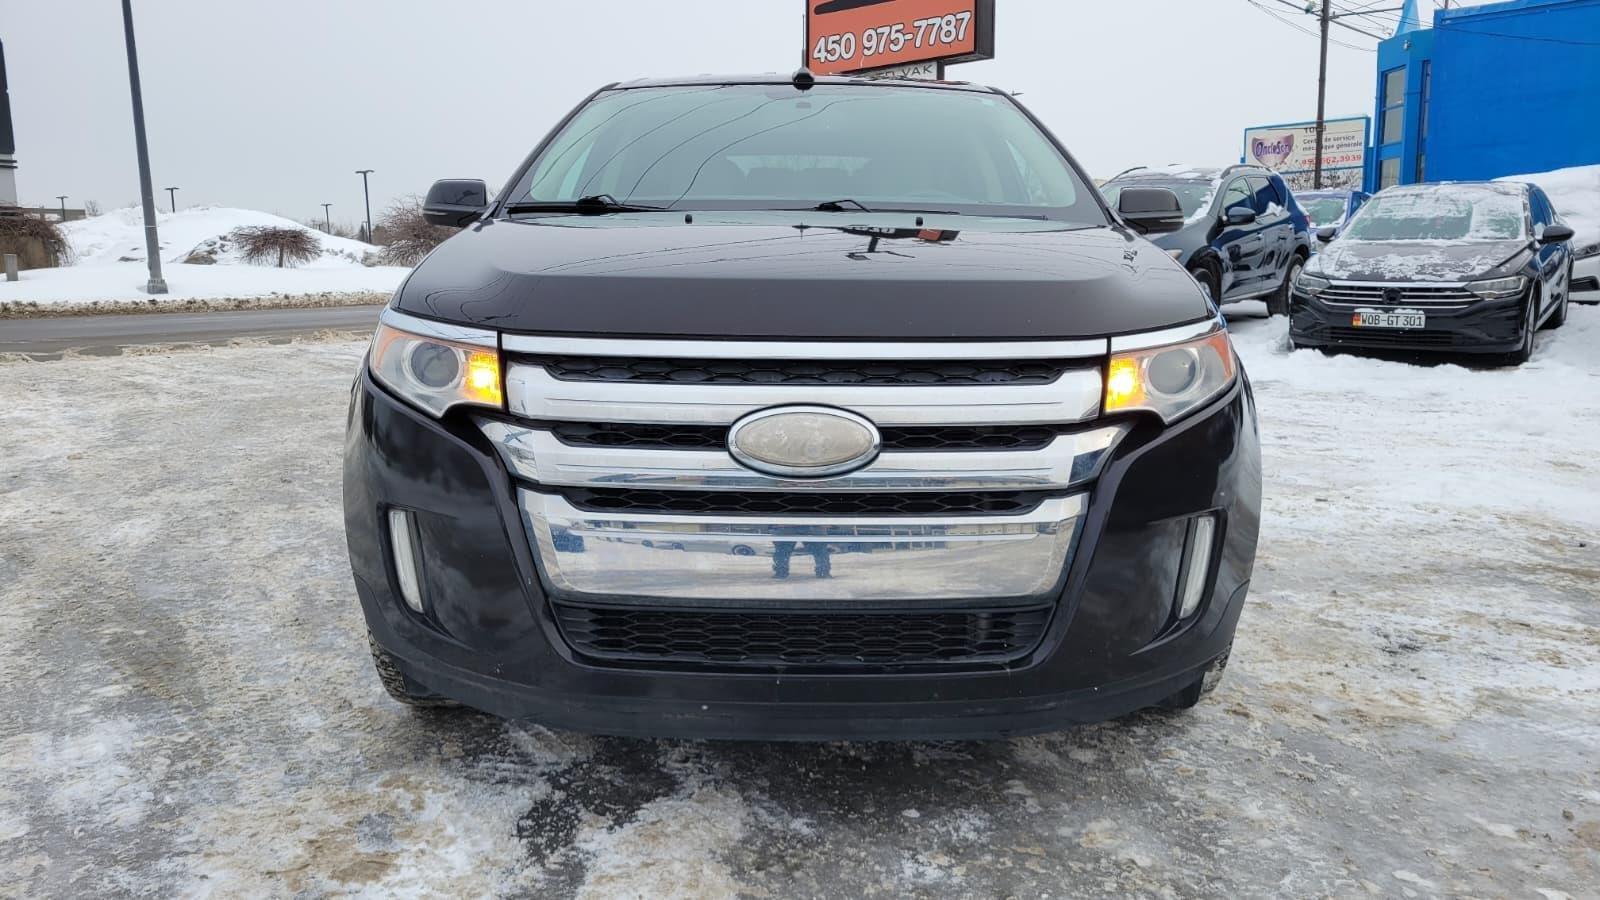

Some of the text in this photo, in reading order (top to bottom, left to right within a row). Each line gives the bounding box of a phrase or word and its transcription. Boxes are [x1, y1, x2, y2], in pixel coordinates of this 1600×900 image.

[812, 11, 972, 63] 450 975-7787
[1361, 314, 1422, 327] WOB-GT 301
